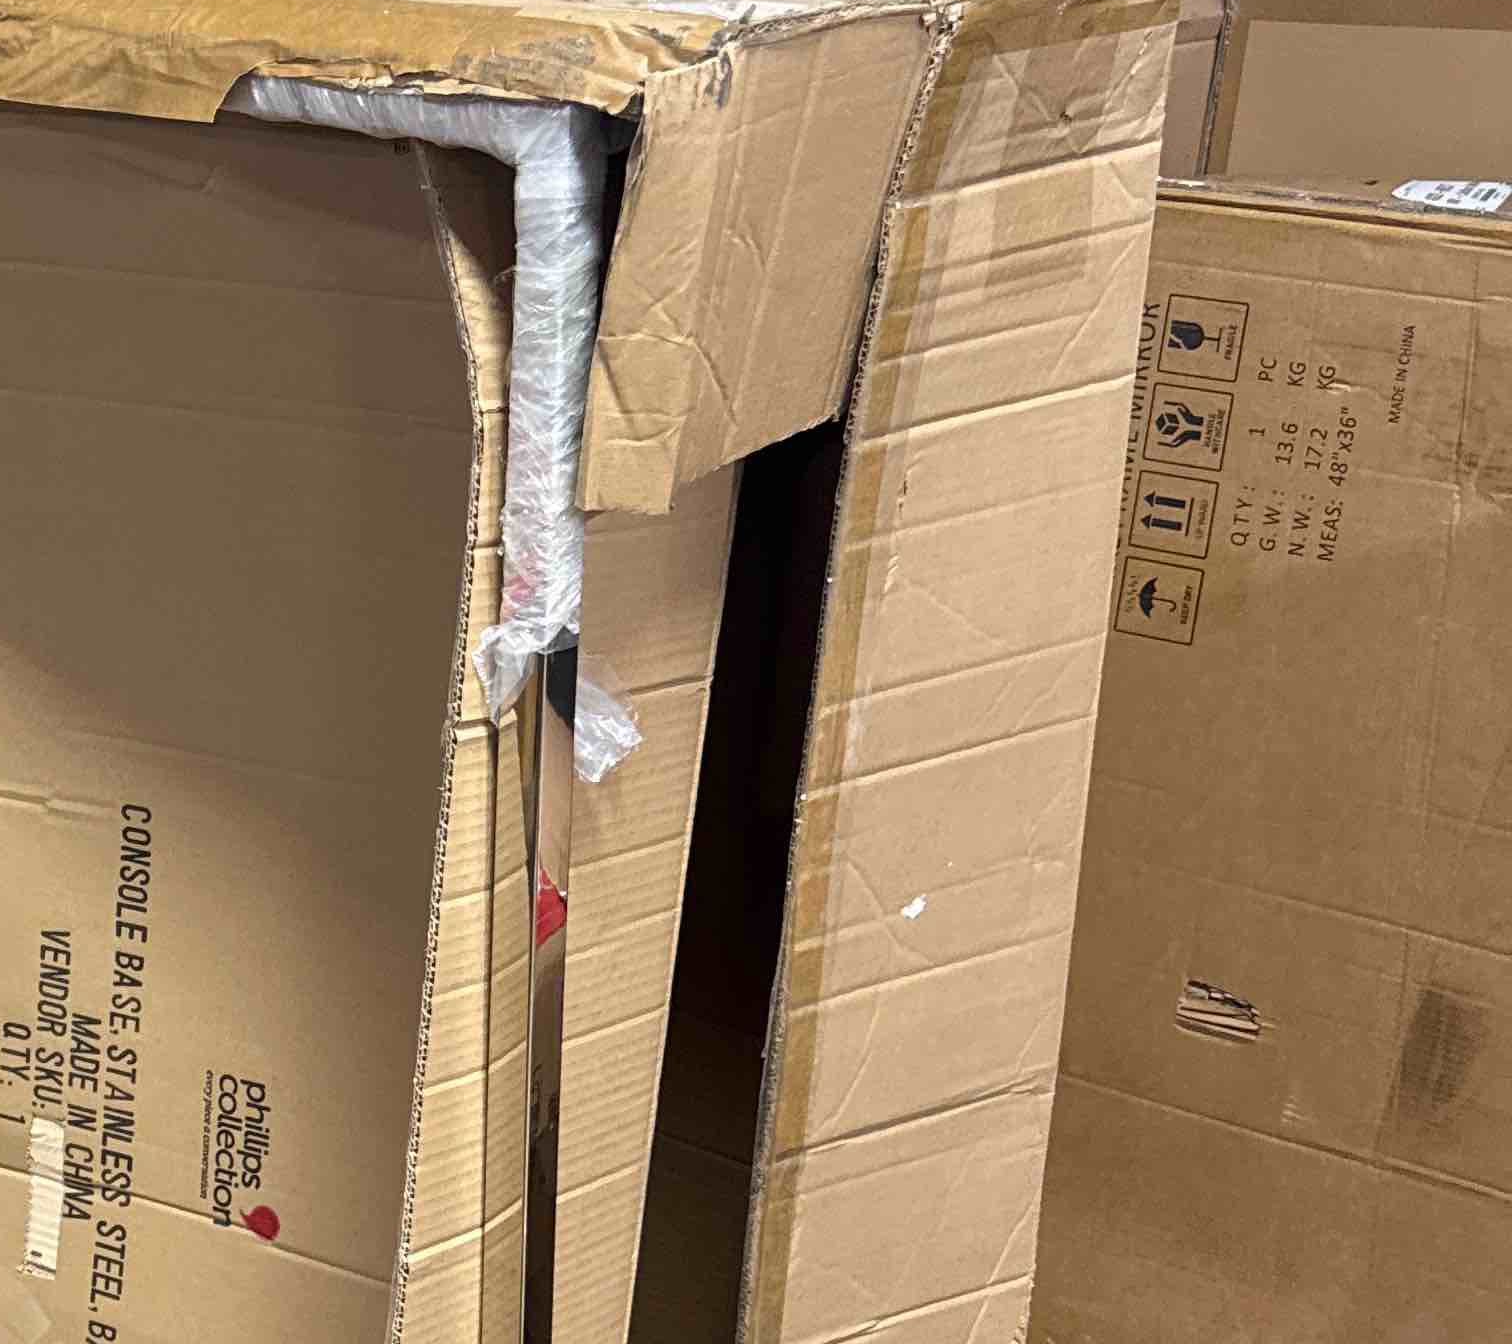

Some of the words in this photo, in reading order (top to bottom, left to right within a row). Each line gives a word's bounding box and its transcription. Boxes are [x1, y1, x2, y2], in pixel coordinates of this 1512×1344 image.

[1257, 356, 1278, 382] PC
[1316, 364, 1337, 391] KG
[1395, 367, 1409, 383] IN
[1398, 325, 1416, 366] CHINA
[1249, 426, 1266, 438] 1
[1274, 422, 1299, 465] 13.6
[1287, 360, 1307, 387] KG
[1388, 385, 1406, 425] MADE
[1304, 427, 1329, 470] 17.2
[1317, 499, 1345, 562] MEAS:
[116, 803, 152, 944] CONSOLE
[36, 928, 72, 1038] VENDOR
[109, 950, 145, 1035] BASE,
[0, 1020, 32, 1087] QTY:
[31, 1046, 64, 1110] SKU:
[68, 1011, 102, 1093] MADE
[66, 1102, 98, 1133] IN
[100, 1043, 138, 1209] STAINLESS
[212, 1073, 243, 1227] collection
[236, 1078, 272, 1191] phillips
[62, 1141, 94, 1221] CHINA
[88, 1219, 128, 1313] STEEL,
